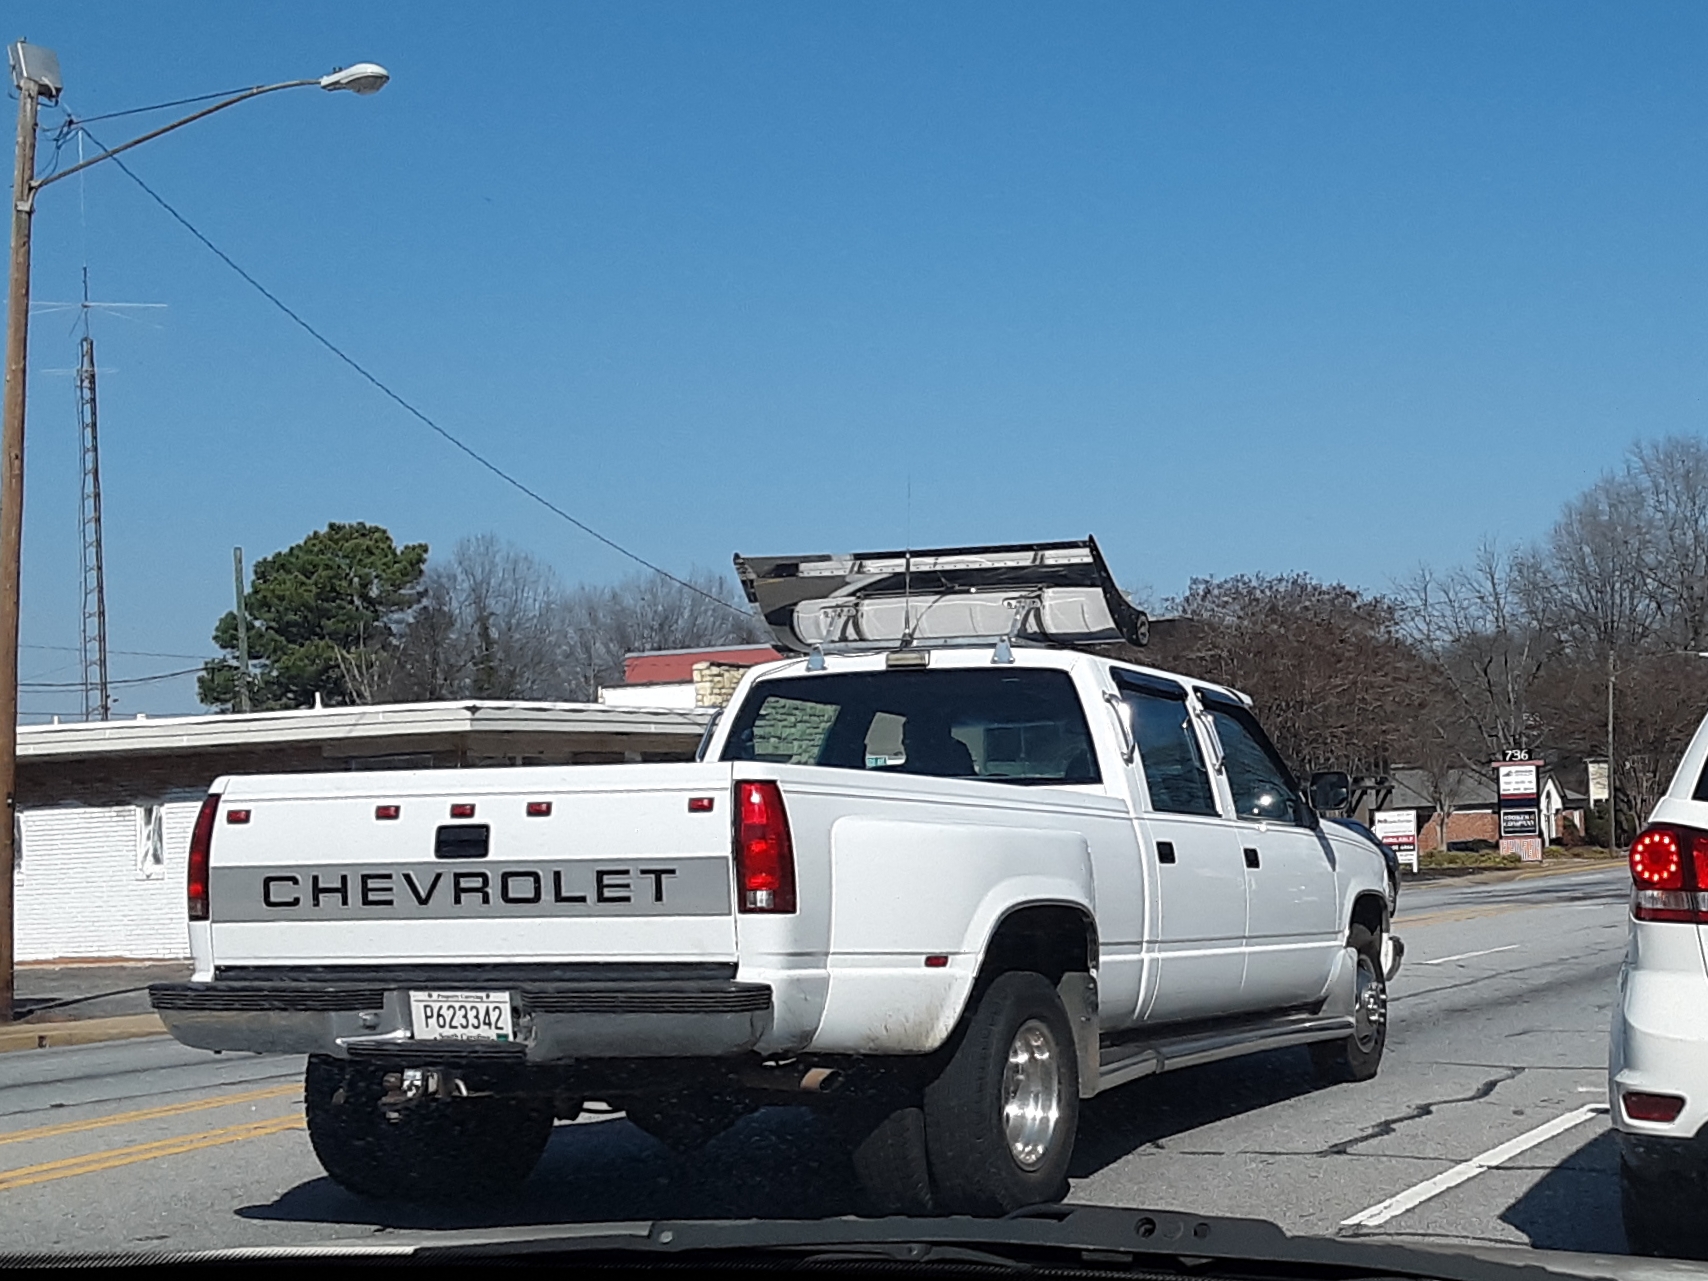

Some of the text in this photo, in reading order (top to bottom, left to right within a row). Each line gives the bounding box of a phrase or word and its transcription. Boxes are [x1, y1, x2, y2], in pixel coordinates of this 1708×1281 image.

[1504, 749, 1529, 761] 736
[262, 868, 677, 908] CHEVROLET
[423, 1004, 504, 1030] P623342
